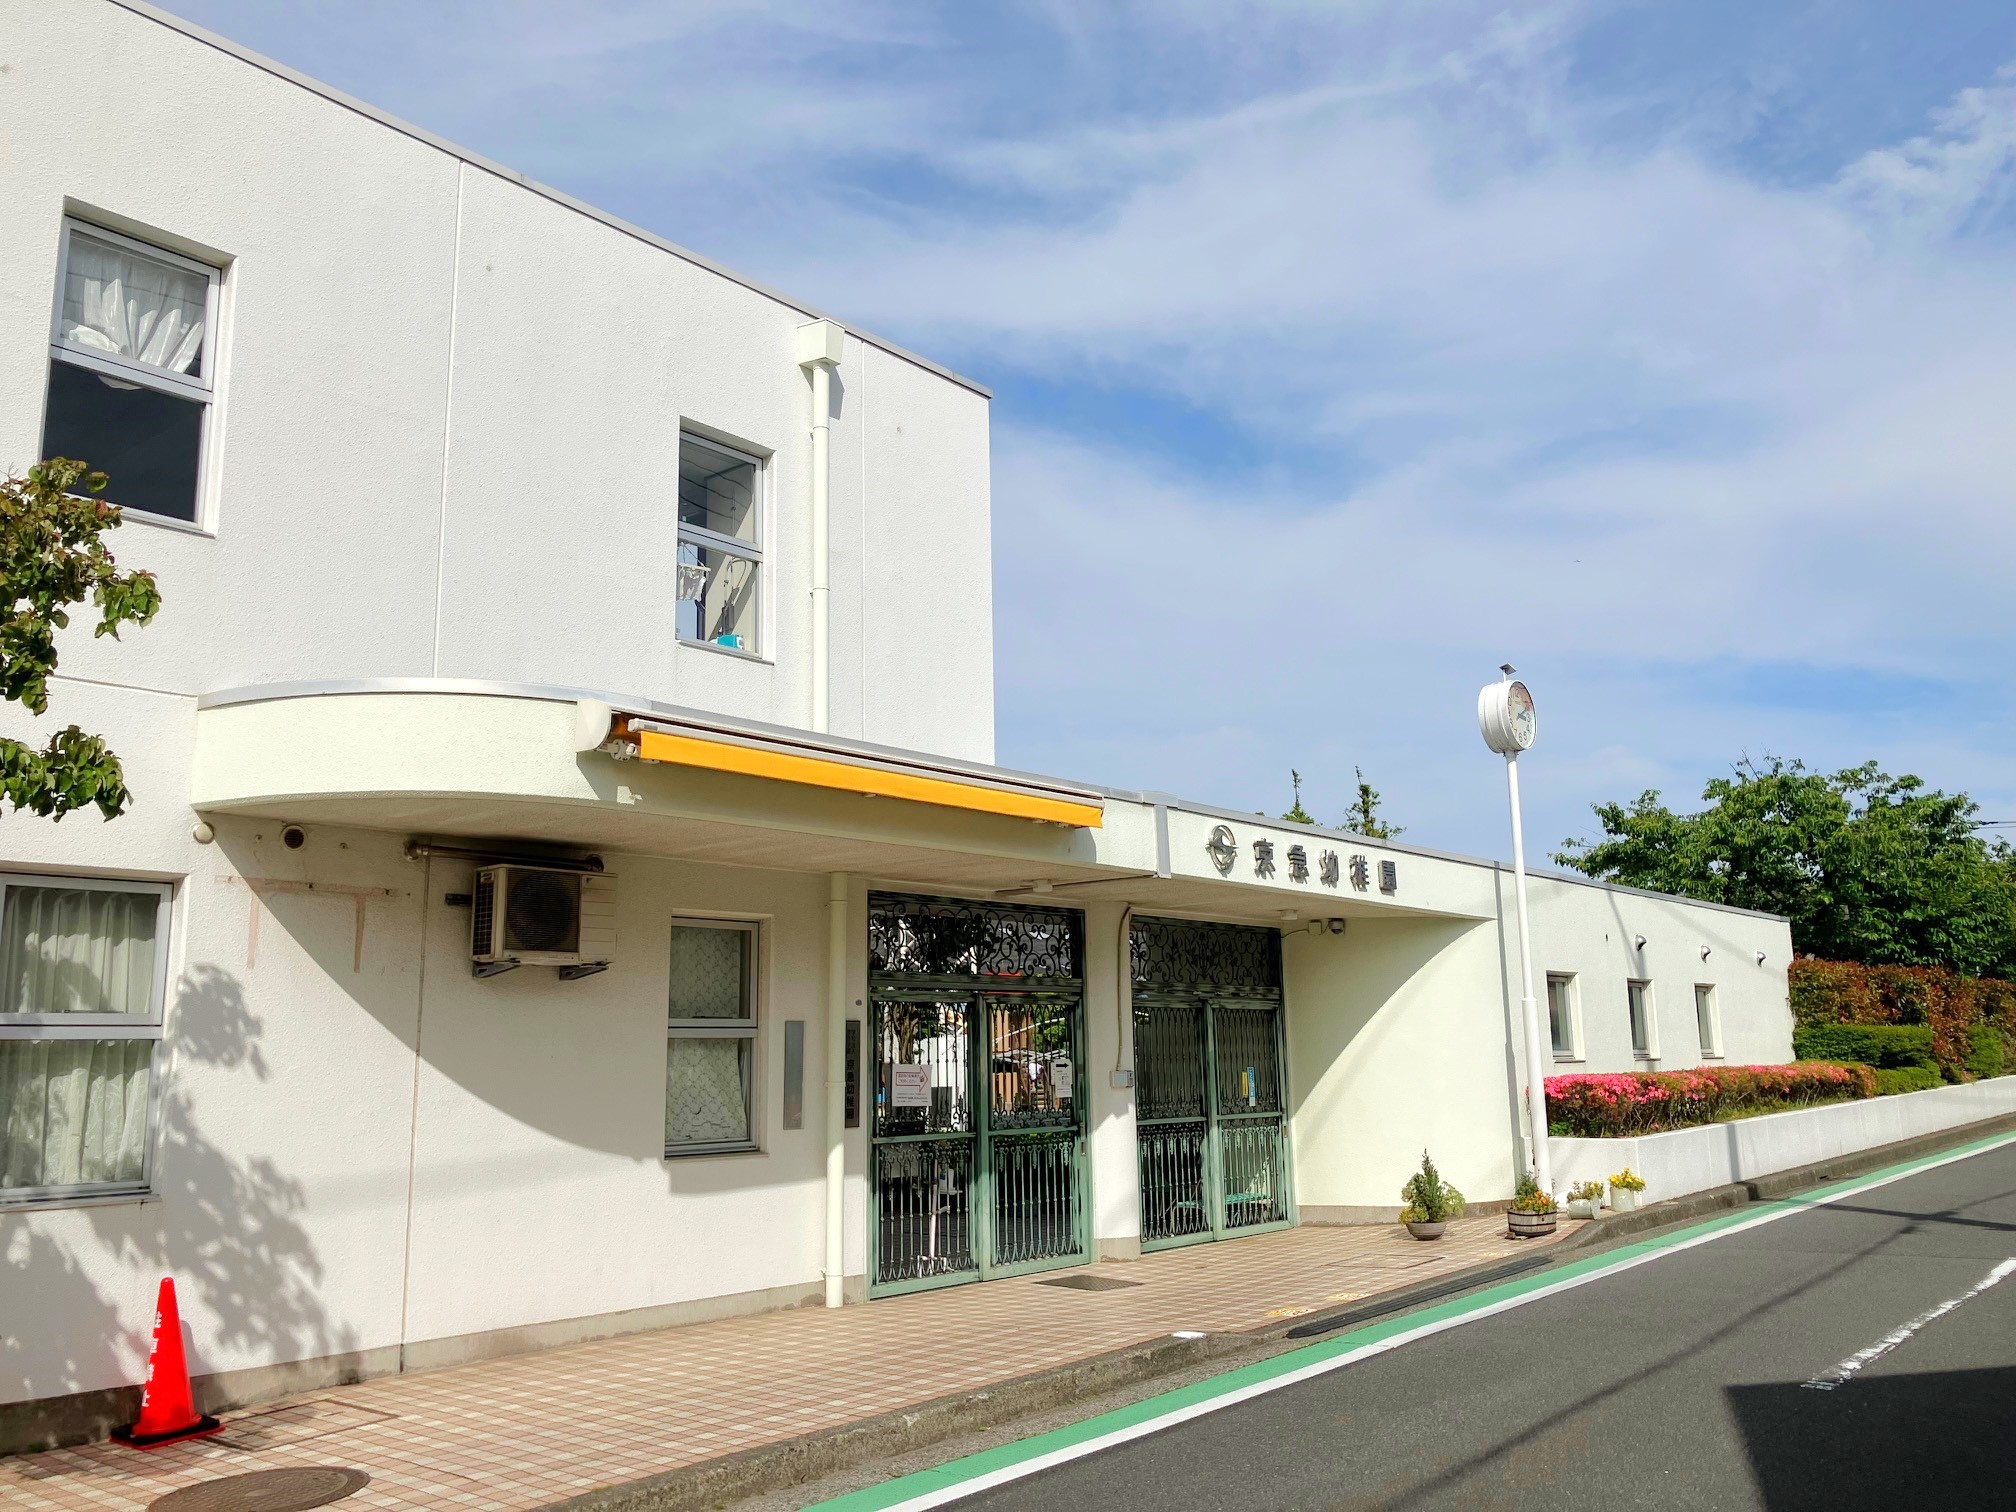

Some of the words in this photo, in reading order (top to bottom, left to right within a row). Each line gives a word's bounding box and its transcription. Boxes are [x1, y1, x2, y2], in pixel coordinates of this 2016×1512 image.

[1253, 838, 1397, 891] 京急幼稚園
